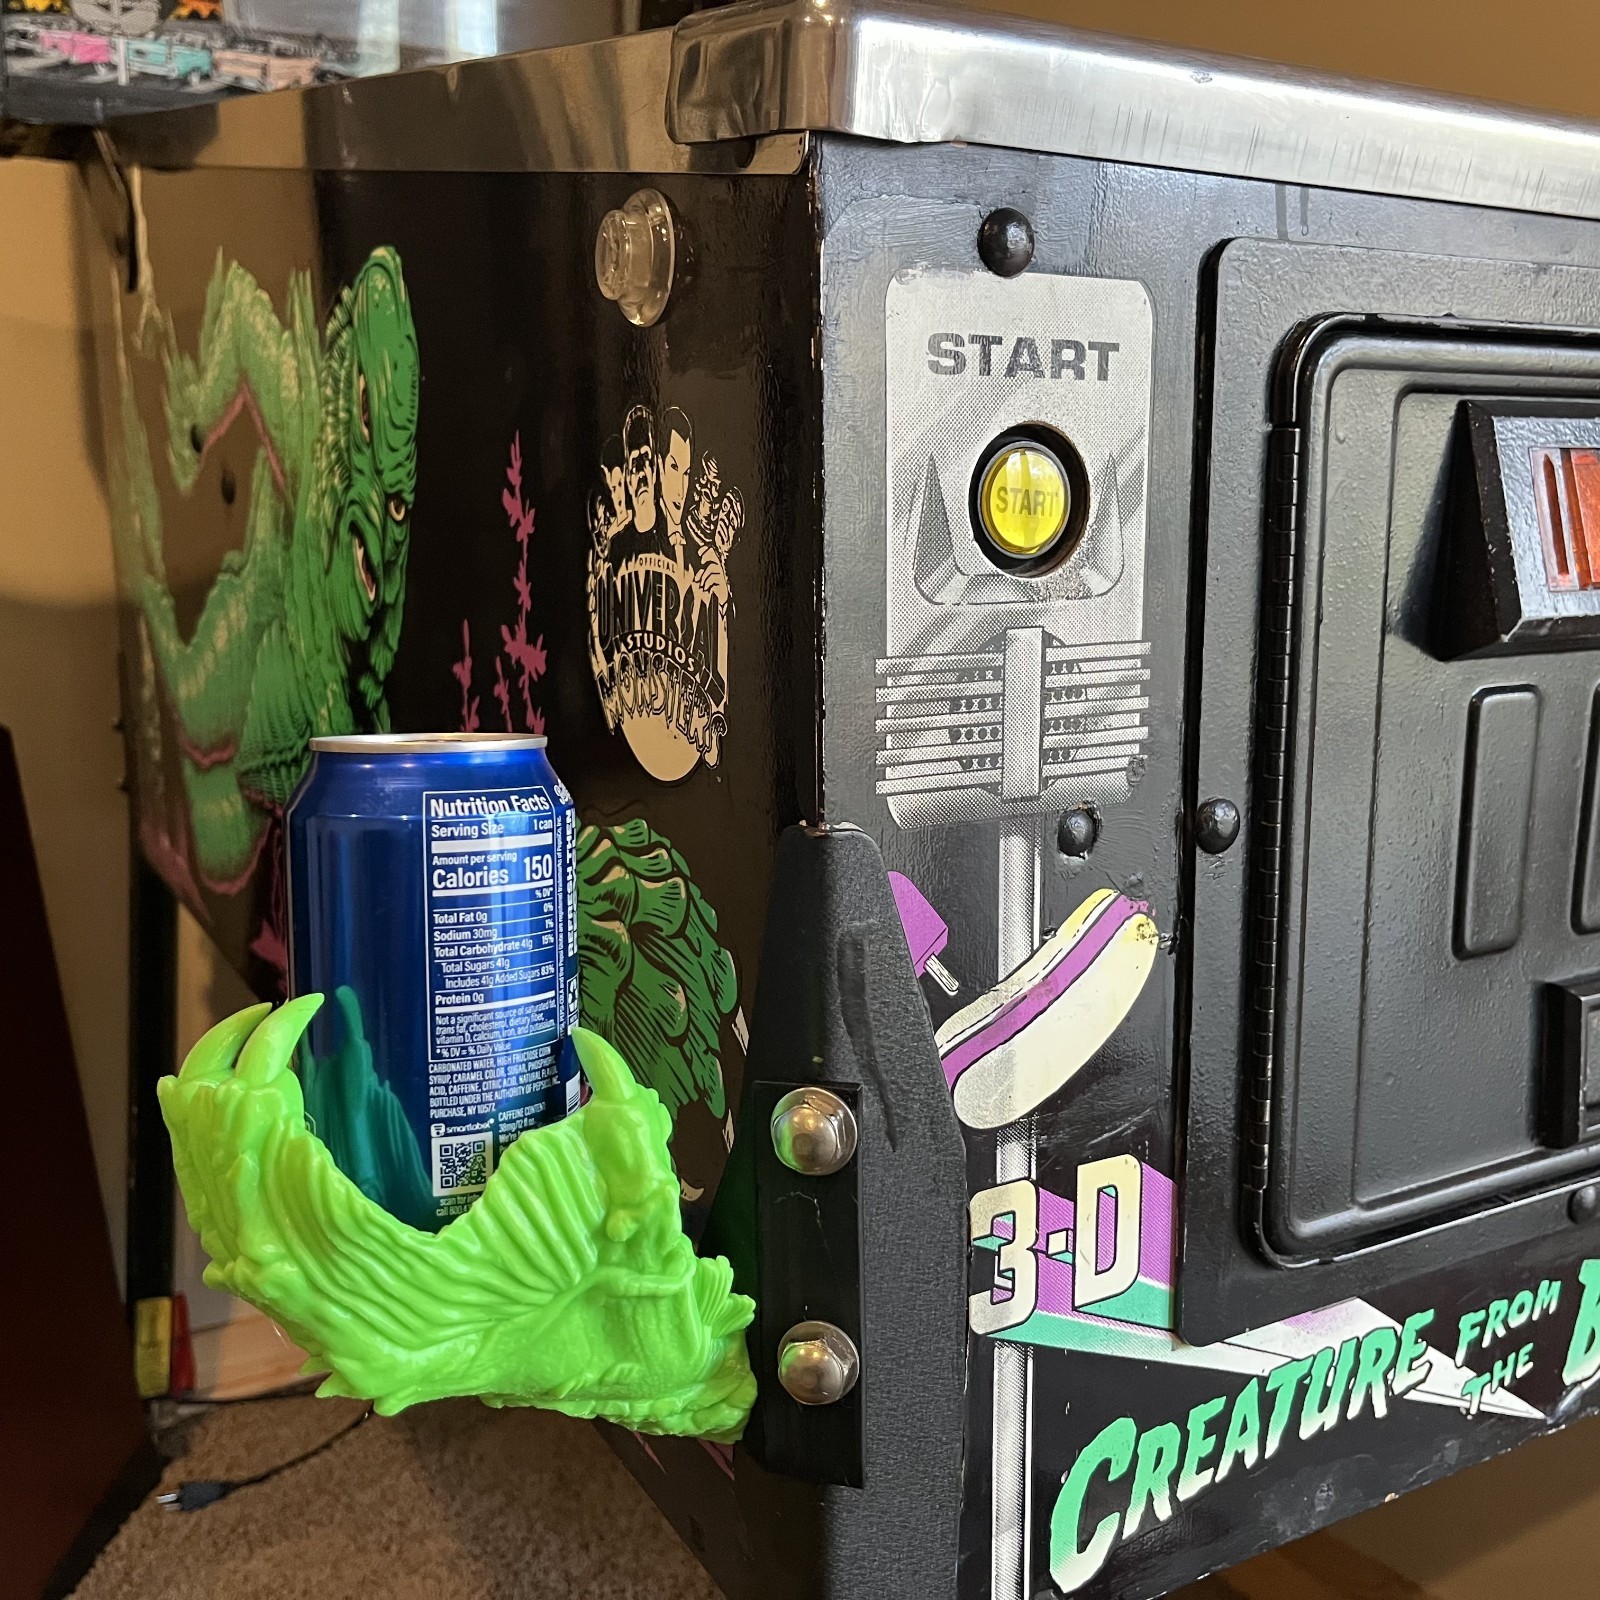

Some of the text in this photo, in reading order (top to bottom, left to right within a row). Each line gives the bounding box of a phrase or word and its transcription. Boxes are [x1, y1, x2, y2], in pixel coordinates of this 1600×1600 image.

[927, 332, 1120, 381] START
[996, 487, 1058, 517] START
[638, 556, 677, 574] OFFICIAL
[596, 563, 726, 708] UNIVERSAL
[626, 633, 696, 673] STUDIOS
[597, 650, 728, 769] MONSTERS
[430, 794, 549, 818] Nutrition Facts
[431, 818, 553, 838] Serving Size 1 can
[432, 851, 517, 867] Amount per serving
[432, 853, 552, 888] Calories 150
[565, 809, 574, 957] REFRESH THEN
[433, 903, 553, 923] Total Fat 0g 0%
[434, 919, 554, 941] Sodium 30mg 1%
[434, 935, 554, 957] Total Carbohydrate 41g 15%
[442, 959, 510, 973] Total Sugars 41g
[445, 965, 555, 989] Includes 41g Added Sugars 83%
[435, 992, 484, 1005] Protein 0g
[436, 1015, 449, 1025] Not
[450, 1016, 456, 1024] a
[457, 1012, 494, 1025] significant
[495, 1008, 516, 1019] source
[518, 1007, 524, 1015] of
[525, 1002, 549, 1015] saturated
[436, 1025, 455, 1035] trans
[456, 1024, 468, 1034] fat,
[469, 1019, 508, 1032] cholesterol,
[509, 1015, 531, 1027] dietary
[436, 1034, 464, 1045] vitamin
[465, 1033, 472, 1043] D,
[473, 1029, 500, 1042] calcium,
[517, 1022, 529, 1033] and
[429, 1061, 472, 1074] CARBONATED
[474, 1059, 496, 1071] WATER,
[497, 1055, 512, 1067] HIGH
[539, 1046, 551, 1057] CORN
[450, 1046, 461, 1057] DV
[477, 1043, 493, 1055] Daily
[493, 1041, 511, 1053] Value
[429, 1074, 452, 1085] SYRUP,
[453, 1071, 484, 1083] CARAMEL
[485, 1068, 506, 1079] COLOR,
[507, 1064, 527, 1077] SUGAR,
[430, 1086, 448, 1097] ACID,
[448, 1082, 481, 1095] CAFFEINE,
[482, 1079, 502, 1091] CITRIC
[503, 1076, 518, 1087] ACID,
[519, 1071, 541, 1084] NATURAL
[430, 1096, 459, 1107] BOTTLED
[459, 1094, 482, 1105] UNDER
[482, 1091, 494, 1102] THE
[494, 1085, 525, 1100] AUTHORITY
[525, 1084, 533, 1095] OF
[430, 1105, 467, 1119] PURCHASE,
[467, 1104, 477, 1115] NY
[498, 1107, 524, 1122] CAFFEINE
[436, 1206, 449, 1217] call
[440, 1197, 456, 1207] scan
[457, 1195, 467, 1205] for
[968, 1154, 1142, 1336] 3-D
[1461, 1342, 1534, 1415] THE
[1049, 1308, 1436, 1594] CREATURE
[1455, 1279, 1561, 1368] FROM
